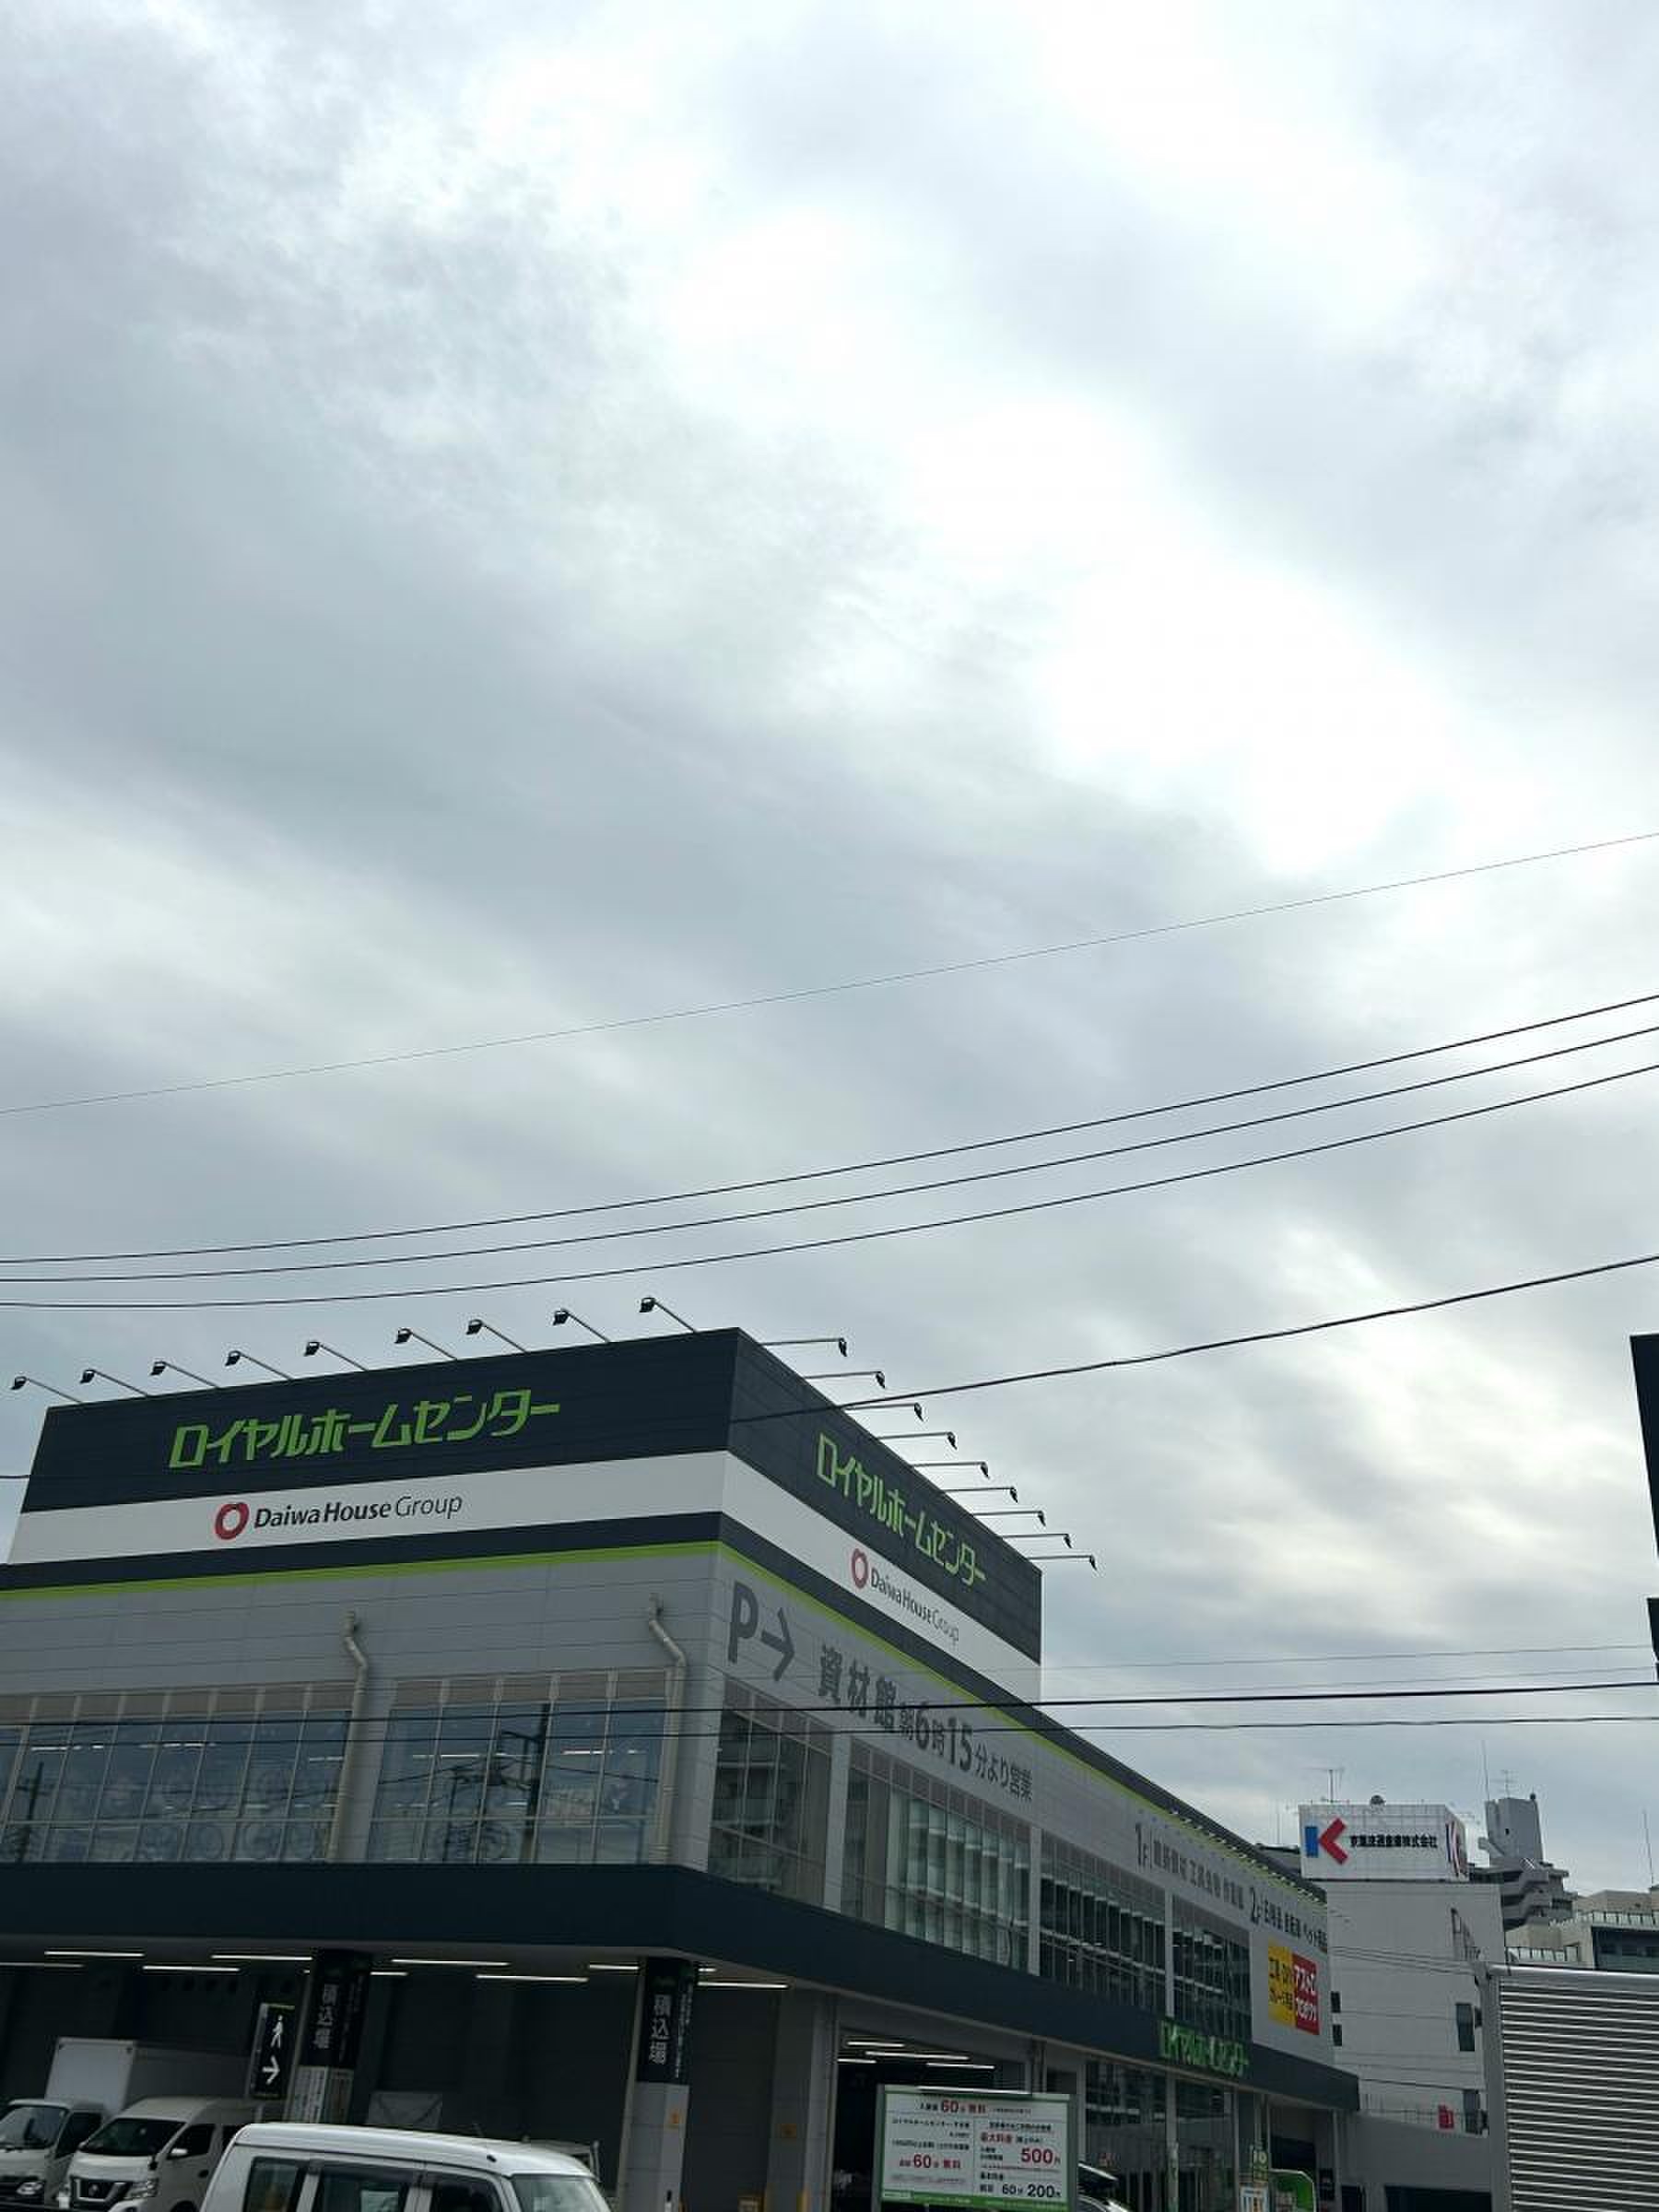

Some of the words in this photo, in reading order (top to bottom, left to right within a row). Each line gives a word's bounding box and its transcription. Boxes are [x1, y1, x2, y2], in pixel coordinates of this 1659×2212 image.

[169, 1389, 560, 1468] ロイヤルホームセンター
[253, 1505, 321, 1529] Daiwa
[323, 1499, 393, 1523] House
[394, 1492, 463, 1522] Group
[816, 1432, 987, 1588] ロイヤルホームセンター
[728, 1580, 759, 1664] P
